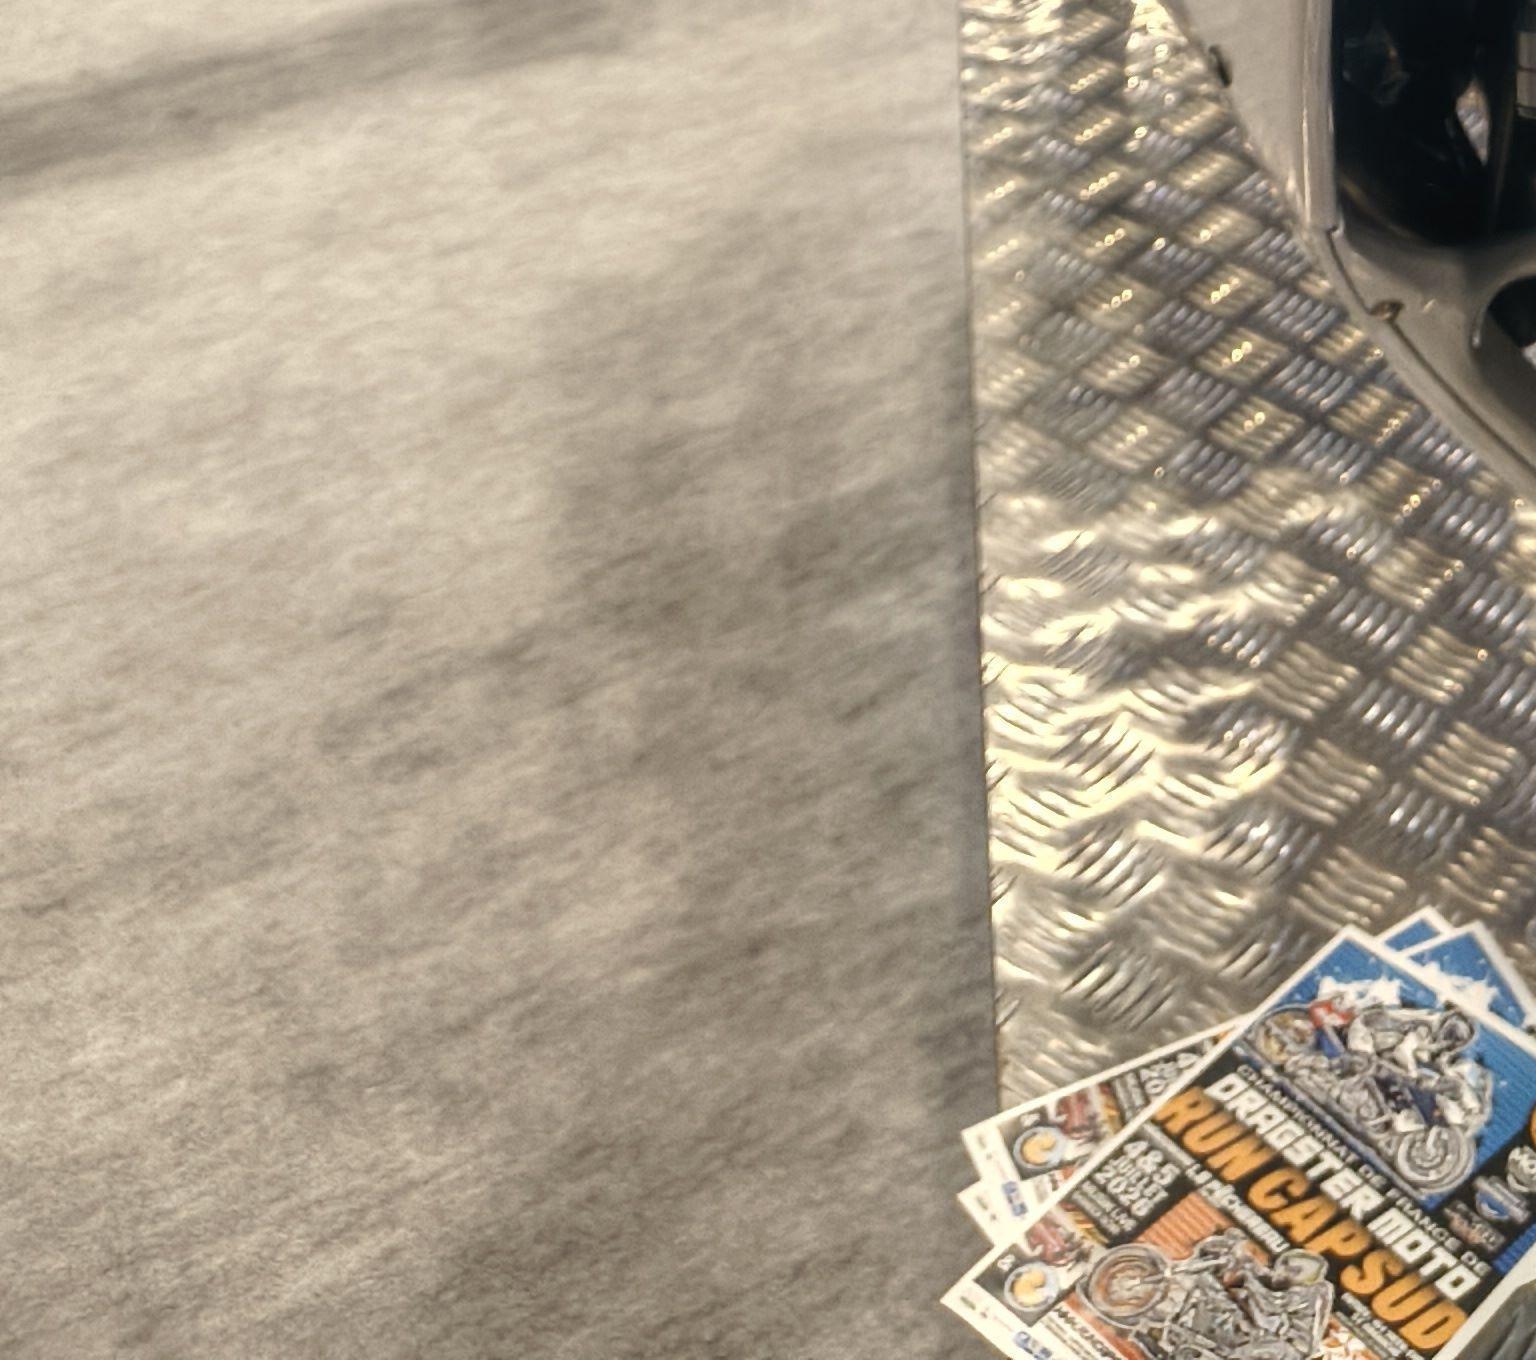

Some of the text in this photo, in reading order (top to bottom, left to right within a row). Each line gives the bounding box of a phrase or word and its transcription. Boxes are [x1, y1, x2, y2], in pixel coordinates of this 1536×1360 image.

[1151, 1085, 1278, 1184] RUN
[1243, 1163, 1374, 1257] CAP
[1336, 1243, 1469, 1350] SUD
[1202, 1071, 1386, 1221] DRAGSTER
[1364, 1206, 1481, 1302] MOTO
